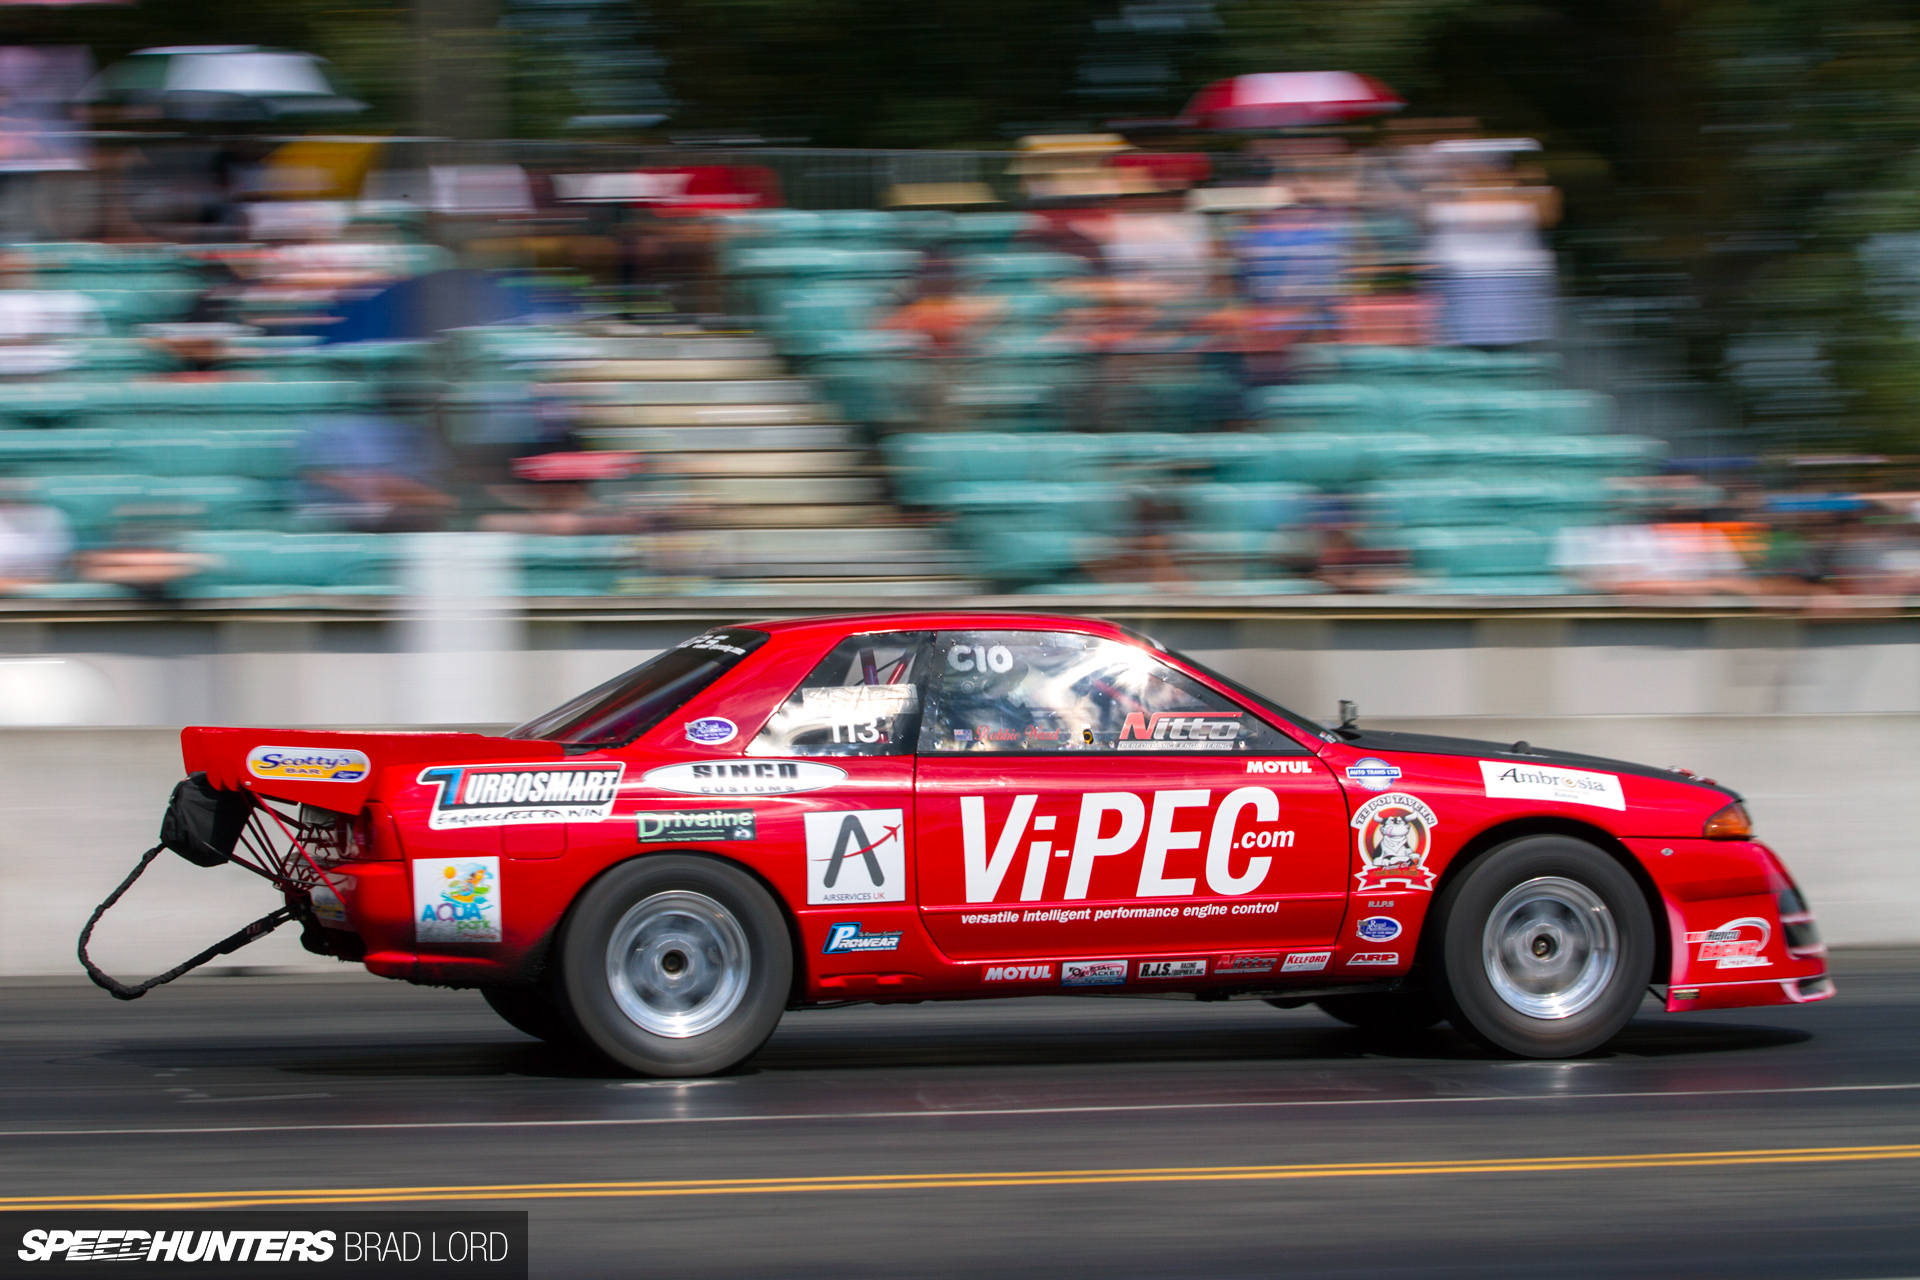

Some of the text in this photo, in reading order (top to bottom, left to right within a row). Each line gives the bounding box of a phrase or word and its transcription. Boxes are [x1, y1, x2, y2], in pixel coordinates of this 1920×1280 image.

[825, 717, 880, 743] 113
[974, 725, 1060, 741] Robbie Ward
[1119, 712, 1243, 740] Nitto
[259, 753, 351, 770] Scotty's
[1246, 761, 1312, 774] MOTUL
[428, 764, 621, 806] TURBOSMART
[1496, 768, 1606, 792] Ambrosia
[1356, 795, 1435, 825] TE POI TAVERN
[636, 811, 754, 837] Driveline
[823, 892, 886, 901] AIRSERVICES UK
[421, 903, 482, 922] AQUA
[961, 901, 1279, 924] versatile intelligent performance engine control
[828, 925, 899, 950] PROWEAR
[1216, 953, 1279, 969] Nitto
[1287, 954, 1328, 964] KELFORD
[1351, 953, 1396, 962] ARP
[984, 965, 1052, 981] MOTUL
[1141, 962, 1171, 977] R.J.S.
